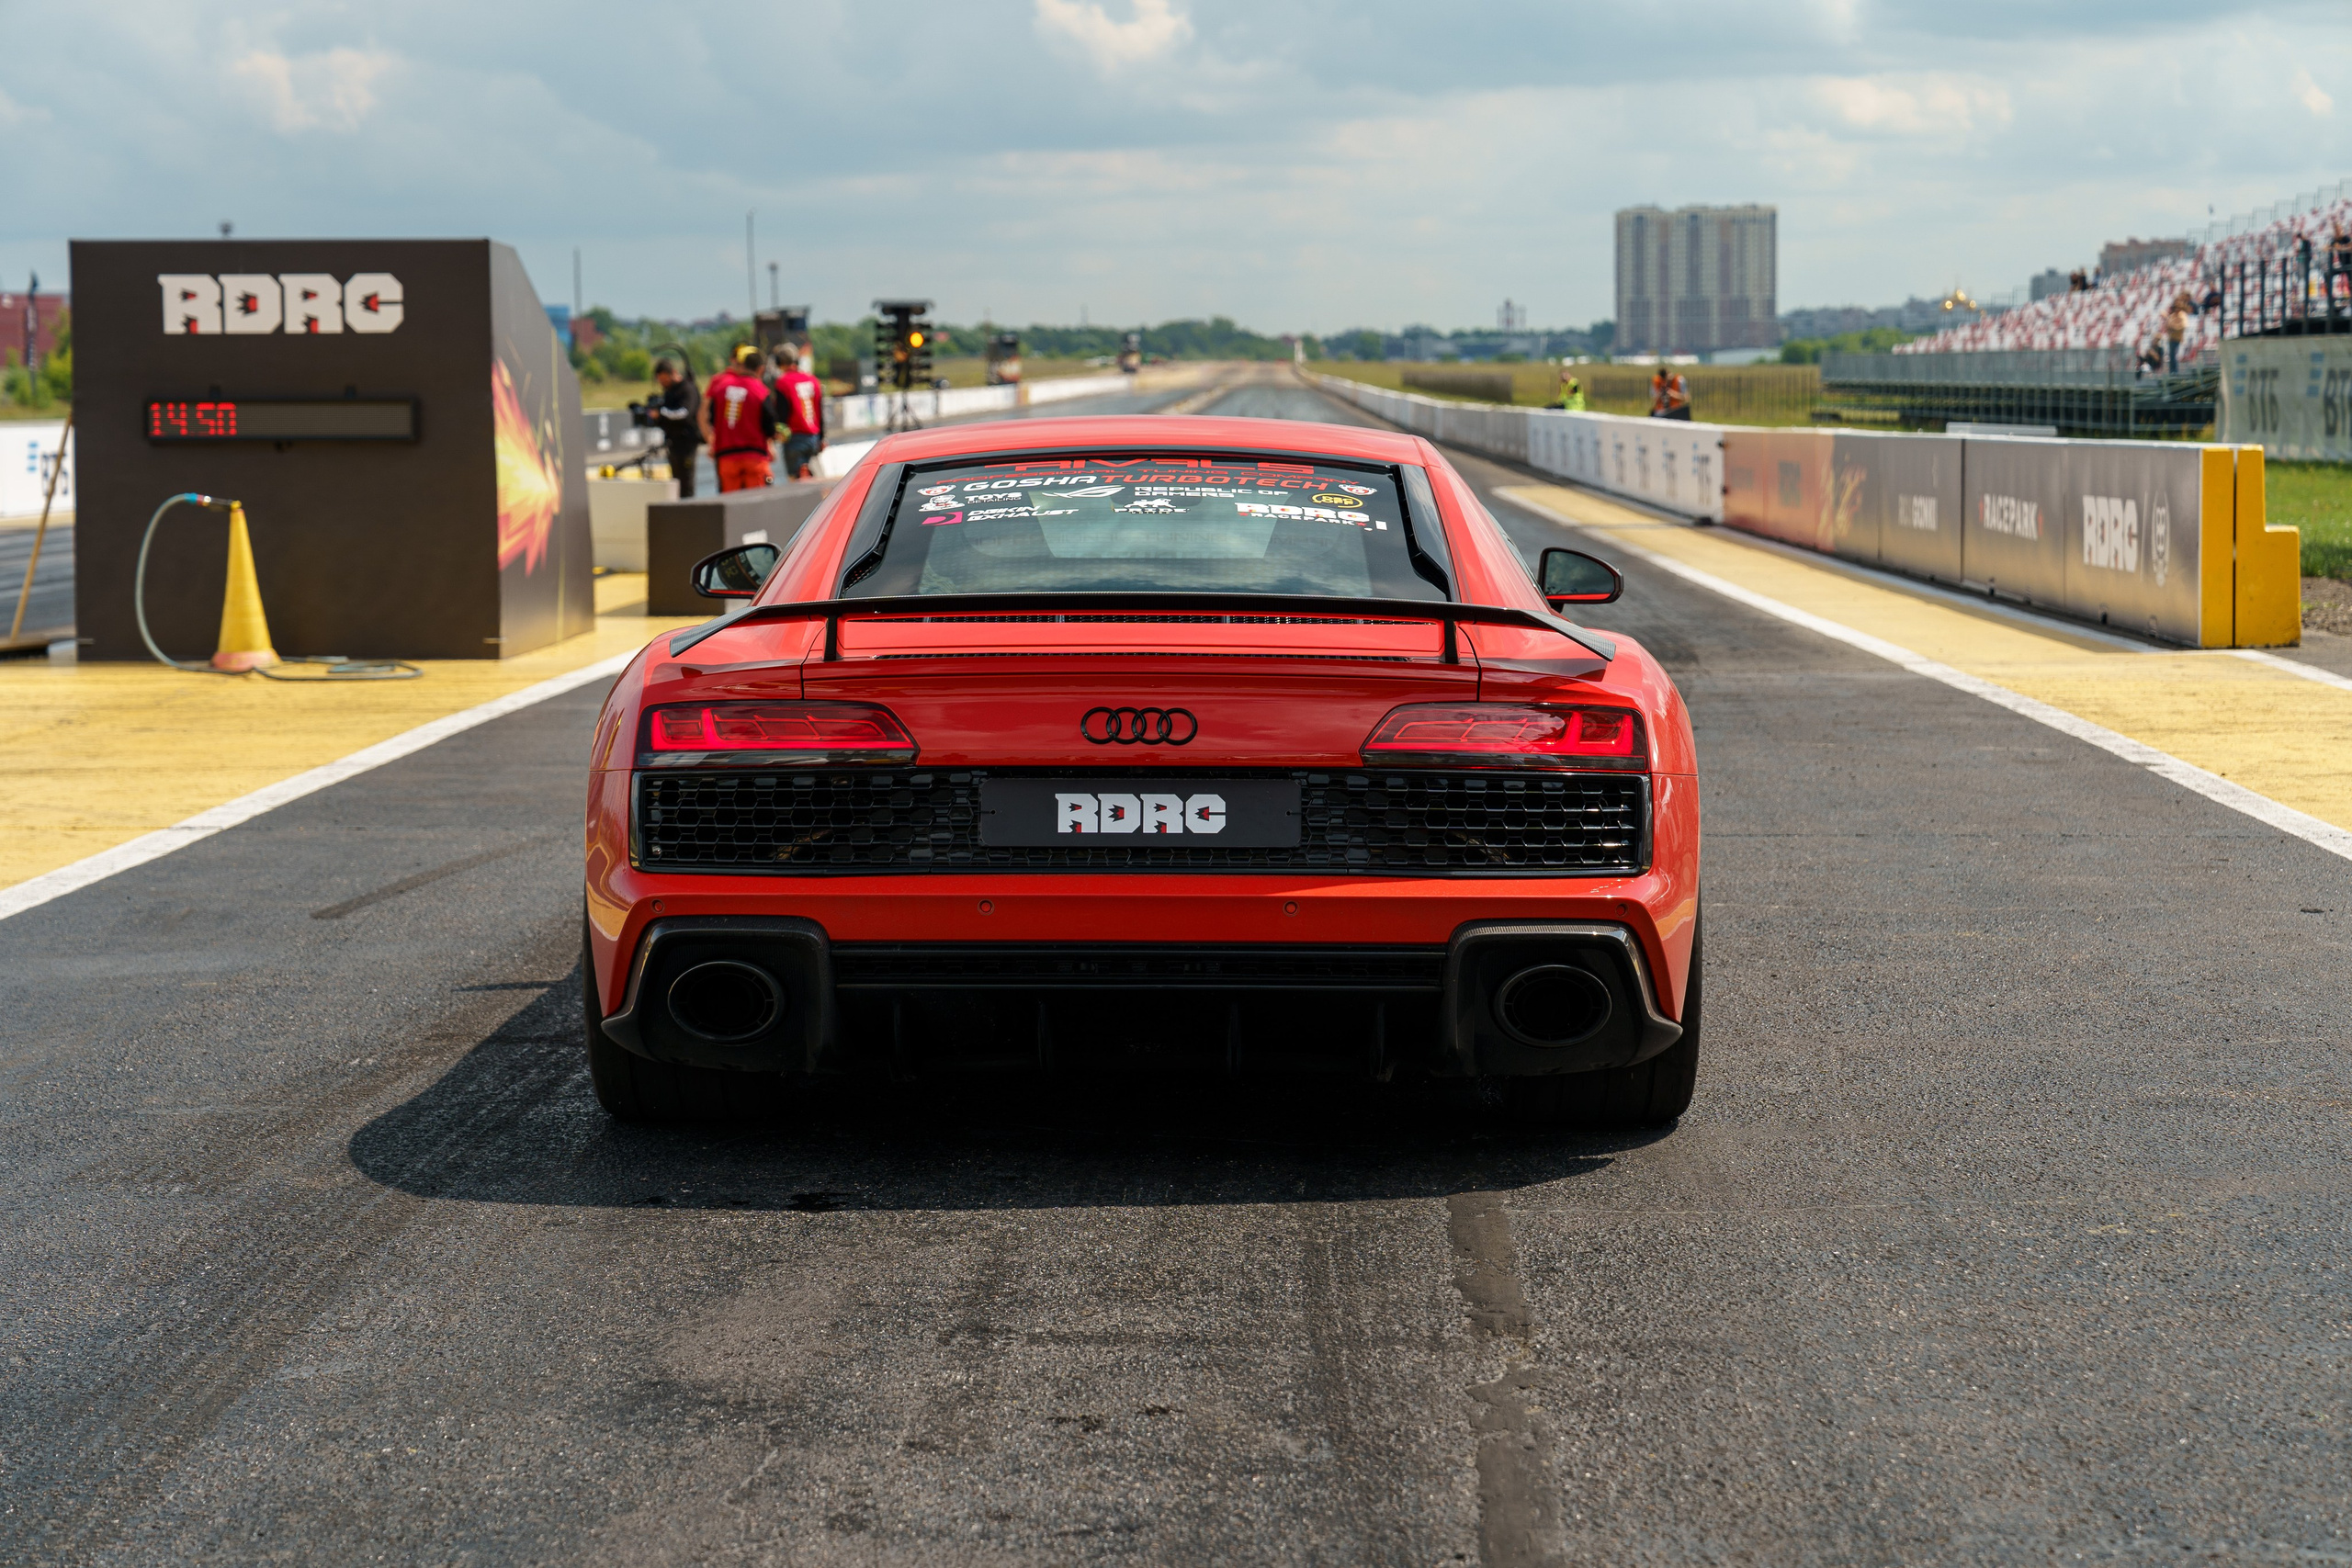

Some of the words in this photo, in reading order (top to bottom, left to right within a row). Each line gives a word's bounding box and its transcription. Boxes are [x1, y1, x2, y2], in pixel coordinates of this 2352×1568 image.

[157, 273, 404, 334] RDRC
[1240, 471, 1360, 485] COMPANY
[965, 491, 1023, 502] TOYS
[1134, 486, 1252, 494] REPUBLIC
[967, 509, 1080, 522] EXHAUST
[1234, 502, 1370, 523] RDRC
[1250, 513, 1355, 526] RACEPARK
[1984, 493, 2038, 541] RACEPARK
[2082, 495, 2138, 573] RDRC
[1055, 793, 1227, 834] RDRC
